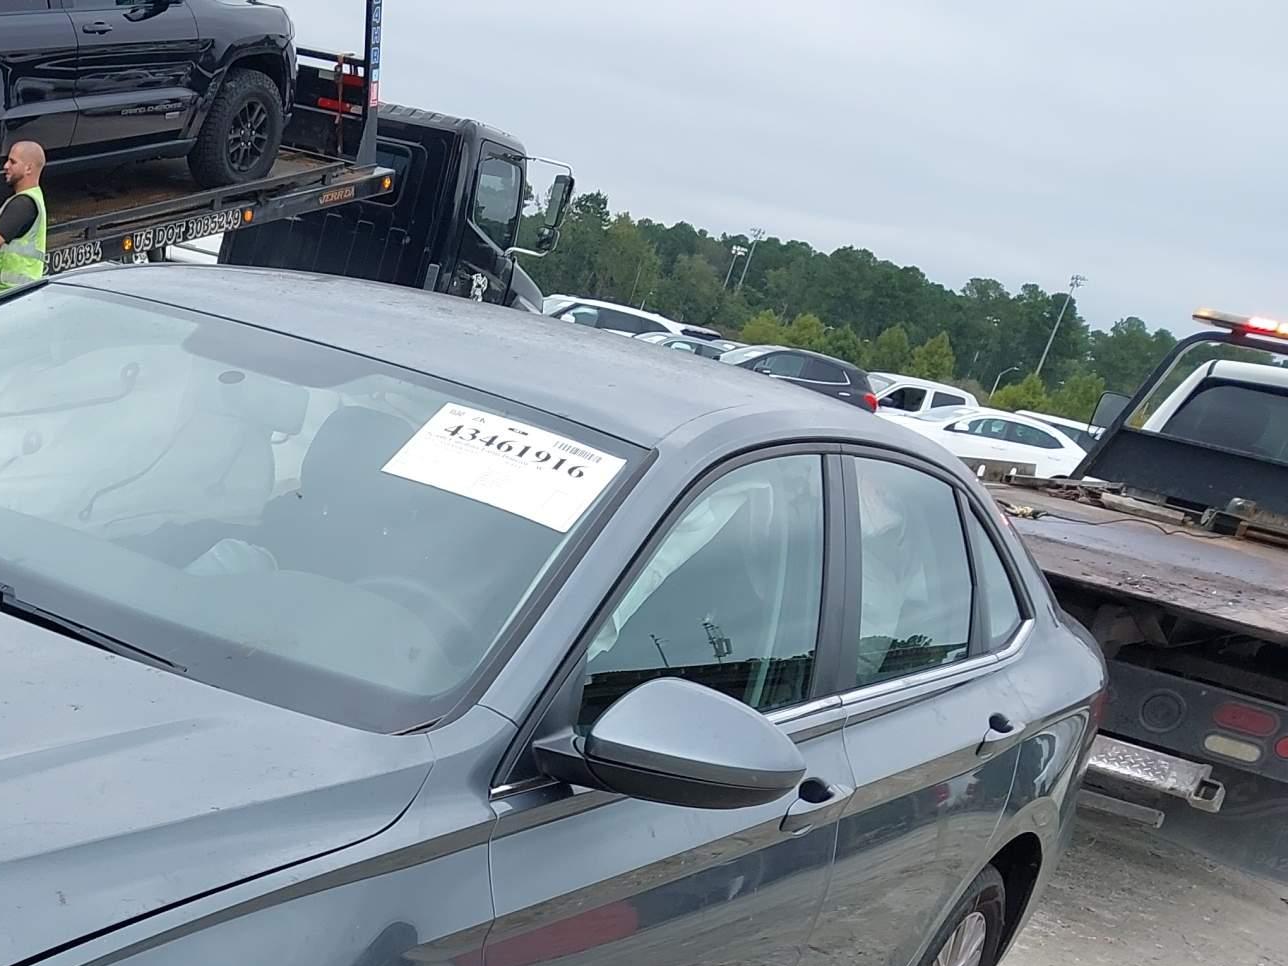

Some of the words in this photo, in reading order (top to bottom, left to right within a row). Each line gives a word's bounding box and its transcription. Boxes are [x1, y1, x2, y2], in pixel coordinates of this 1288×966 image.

[133, 230, 153, 252] US
[155, 222, 186, 248] DOT
[52, 240, 103, 272] 041634
[444, 424, 589, 479] 43461916
